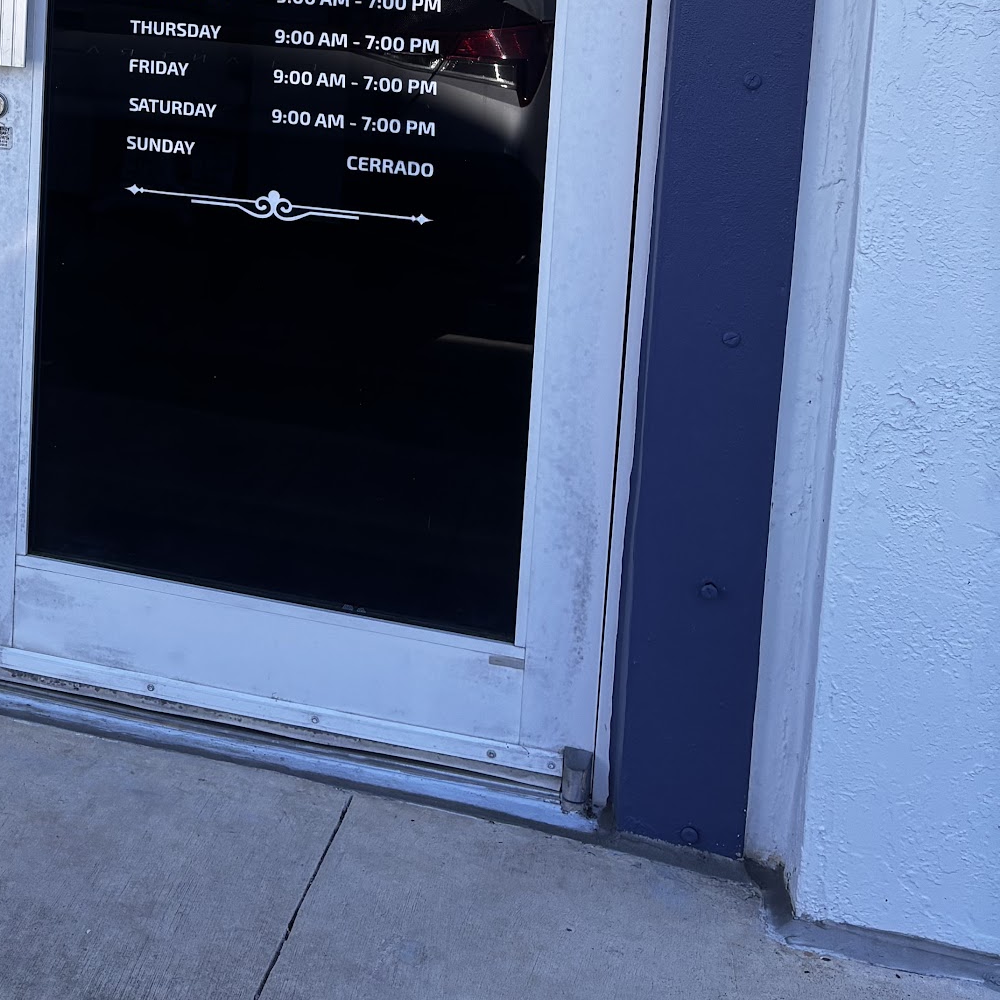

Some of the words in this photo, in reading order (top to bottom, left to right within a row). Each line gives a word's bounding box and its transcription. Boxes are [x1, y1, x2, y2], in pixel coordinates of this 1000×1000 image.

[129, 19, 222, 40] THURSDAY
[274, 29, 315, 46] 9:00
[317, 32, 348, 48] AM
[364, 34, 405, 52] 7:00
[409, 37, 440, 55] PM
[129, 58, 189, 77] FRIDAY
[273, 69, 313, 86] 9:00
[315, 72, 346, 89] AM
[363, 75, 403, 92] 7:00
[407, 79, 438, 96] PM
[129, 97, 217, 118] SATURDAY
[271, 108, 311, 126] 9:00
[314, 113, 345, 129] AM
[361, 116, 401, 134] 7:00
[406, 120, 436, 137] PM
[126, 135, 196, 155] SUNDAY
[346, 155, 434, 178] CERRADO
